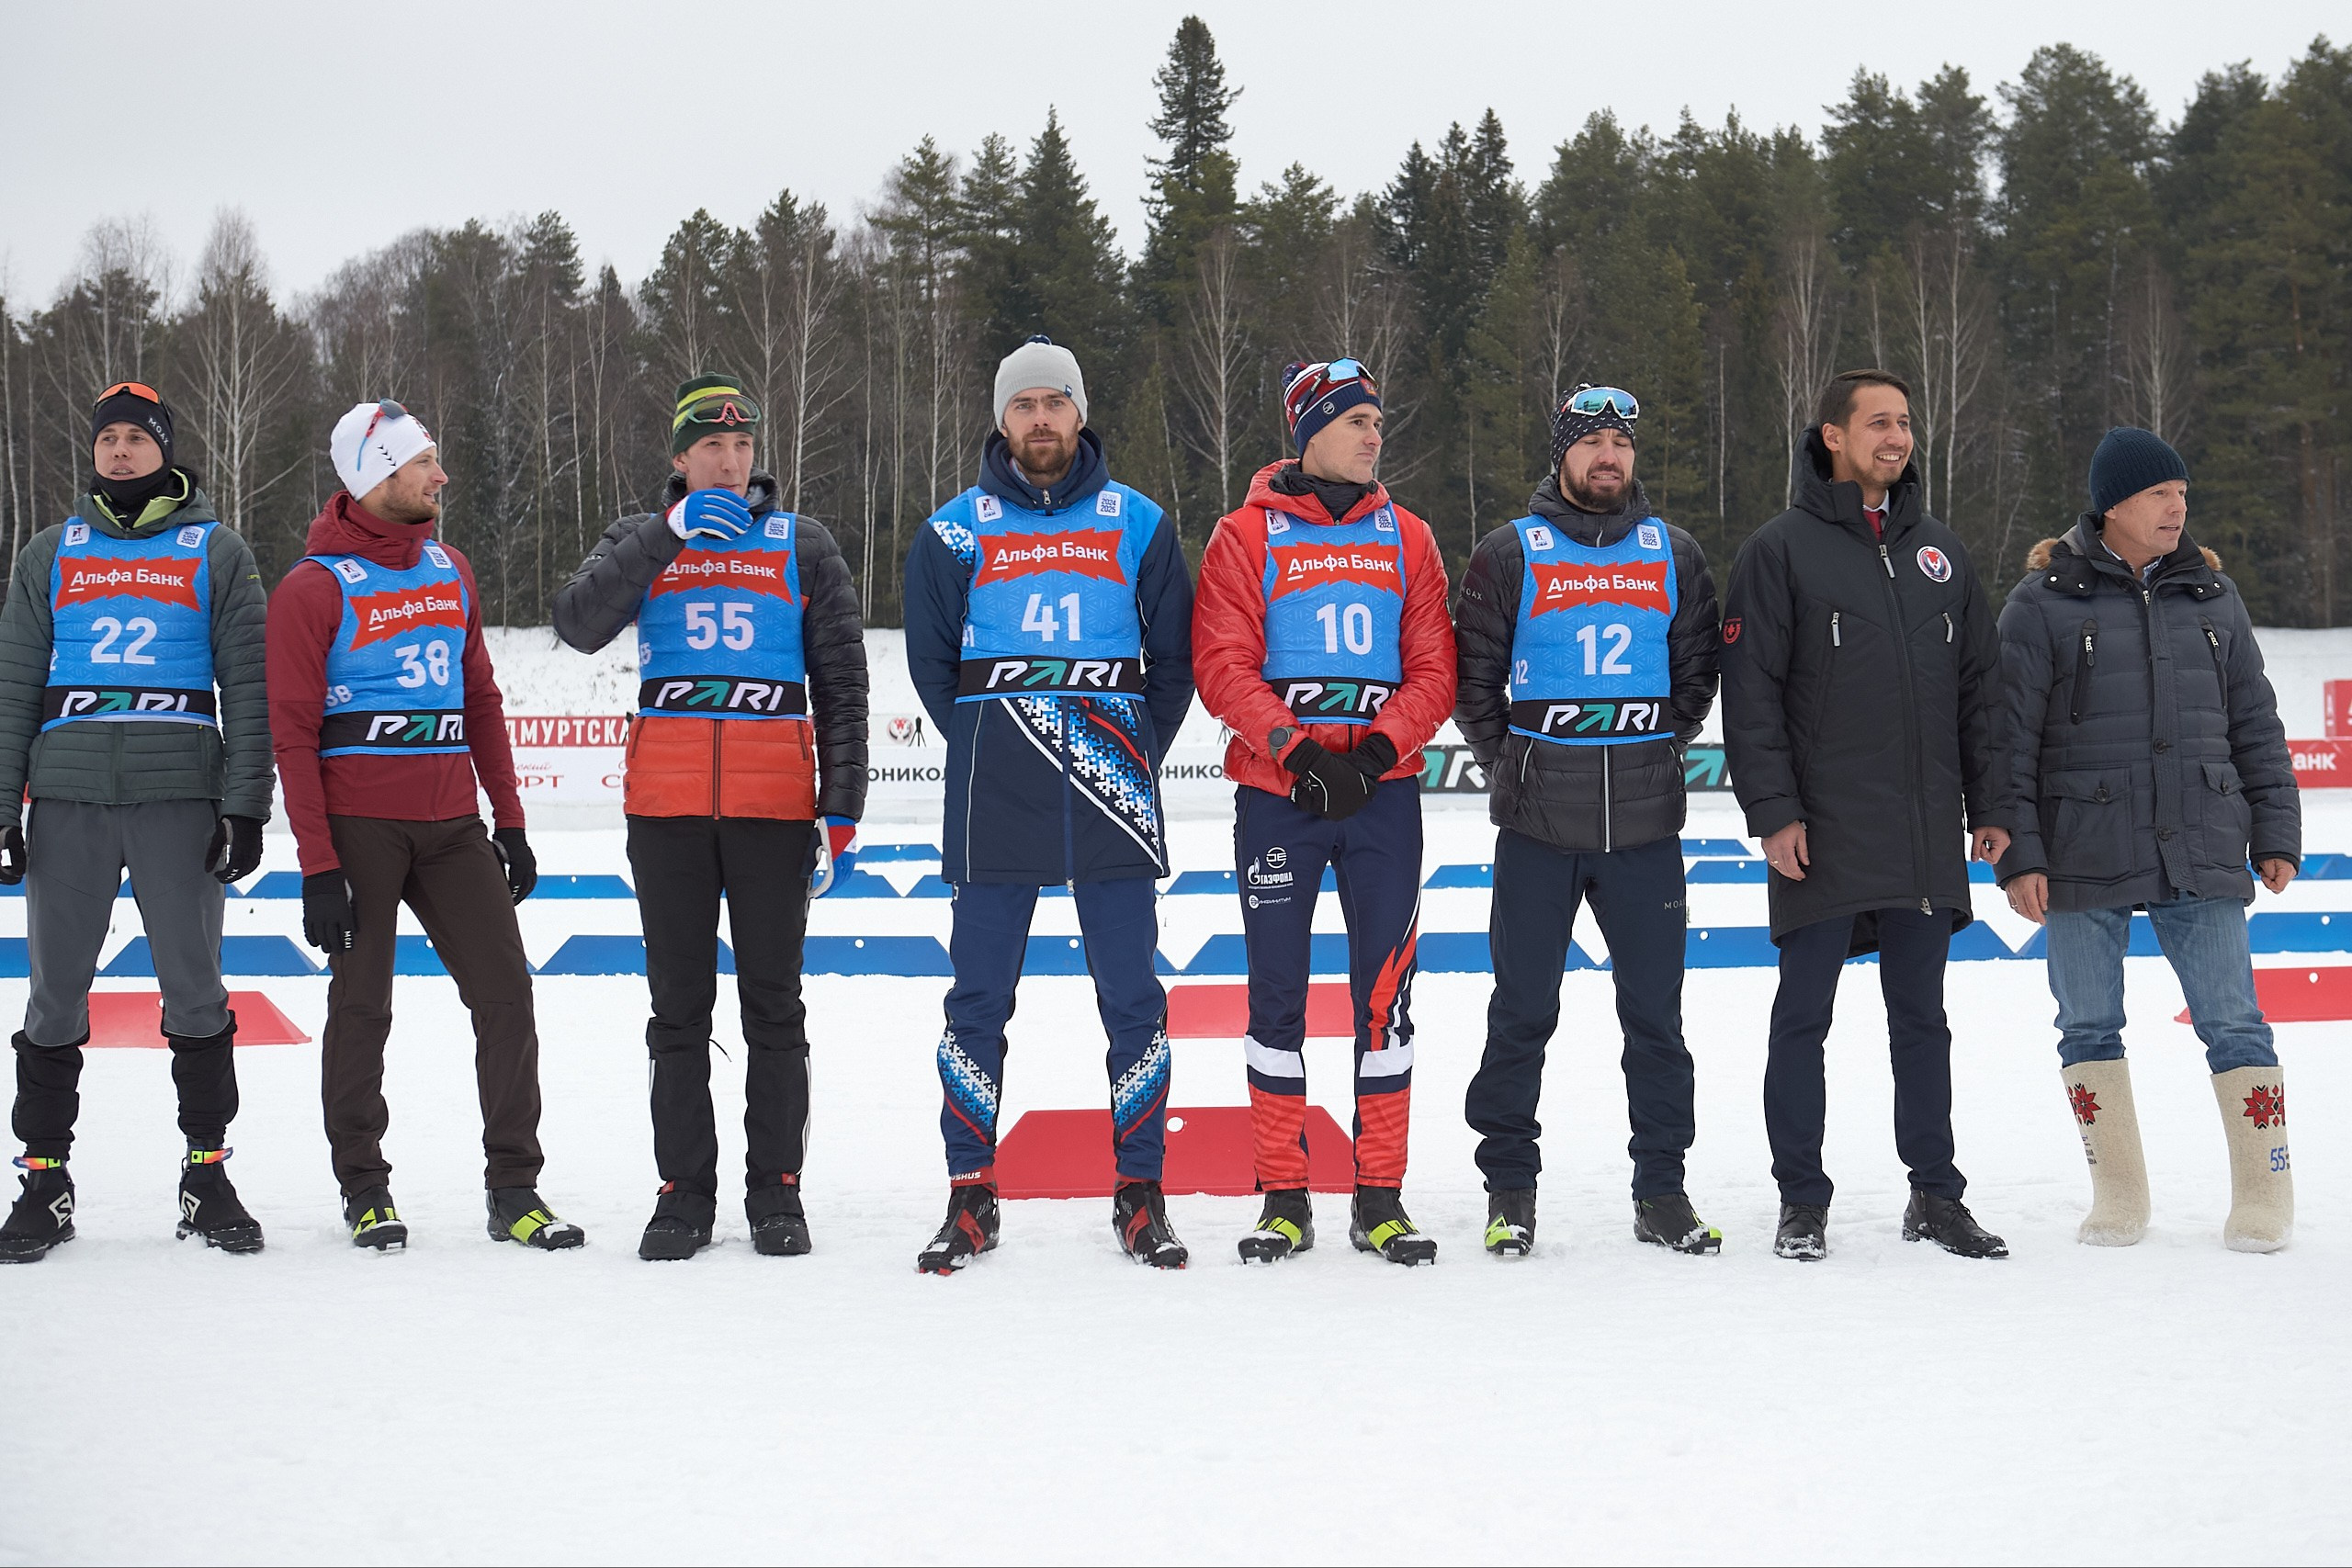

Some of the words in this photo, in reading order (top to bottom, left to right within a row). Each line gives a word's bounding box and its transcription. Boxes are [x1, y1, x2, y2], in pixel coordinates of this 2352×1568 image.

[148, 417, 169, 446] MOAX
[993, 544, 1058, 564] Альфа
[1061, 542, 1110, 562] Банк
[1642, 537, 1657, 546] 2025
[71, 568, 132, 586] Альфа
[136, 569, 185, 587] Банк
[663, 559, 726, 577] Альфа
[729, 560, 777, 579] Банк
[1287, 553, 1349, 575] Альфа
[1351, 554, 1396, 573] Банк
[1547, 574, 1610, 593] Альфа
[1612, 574, 1659, 592] Банк
[368, 600, 425, 626] Альфа
[425, 596, 460, 613] Банк
[1021, 592, 1081, 642] 41
[90, 616, 158, 665] 22
[684, 602, 755, 651] 55
[1316, 603, 1374, 656] 10
[395, 639, 450, 689] 38
[1576, 623, 1633, 676] 12
[986, 660, 1123, 689] PARI
[1516, 659, 1529, 685] 12
[654, 681, 785, 712] PARI
[1283, 682, 1396, 714] PAR
[1541, 702, 1660, 734] PARI
[2289, 749, 2337, 771] анк
